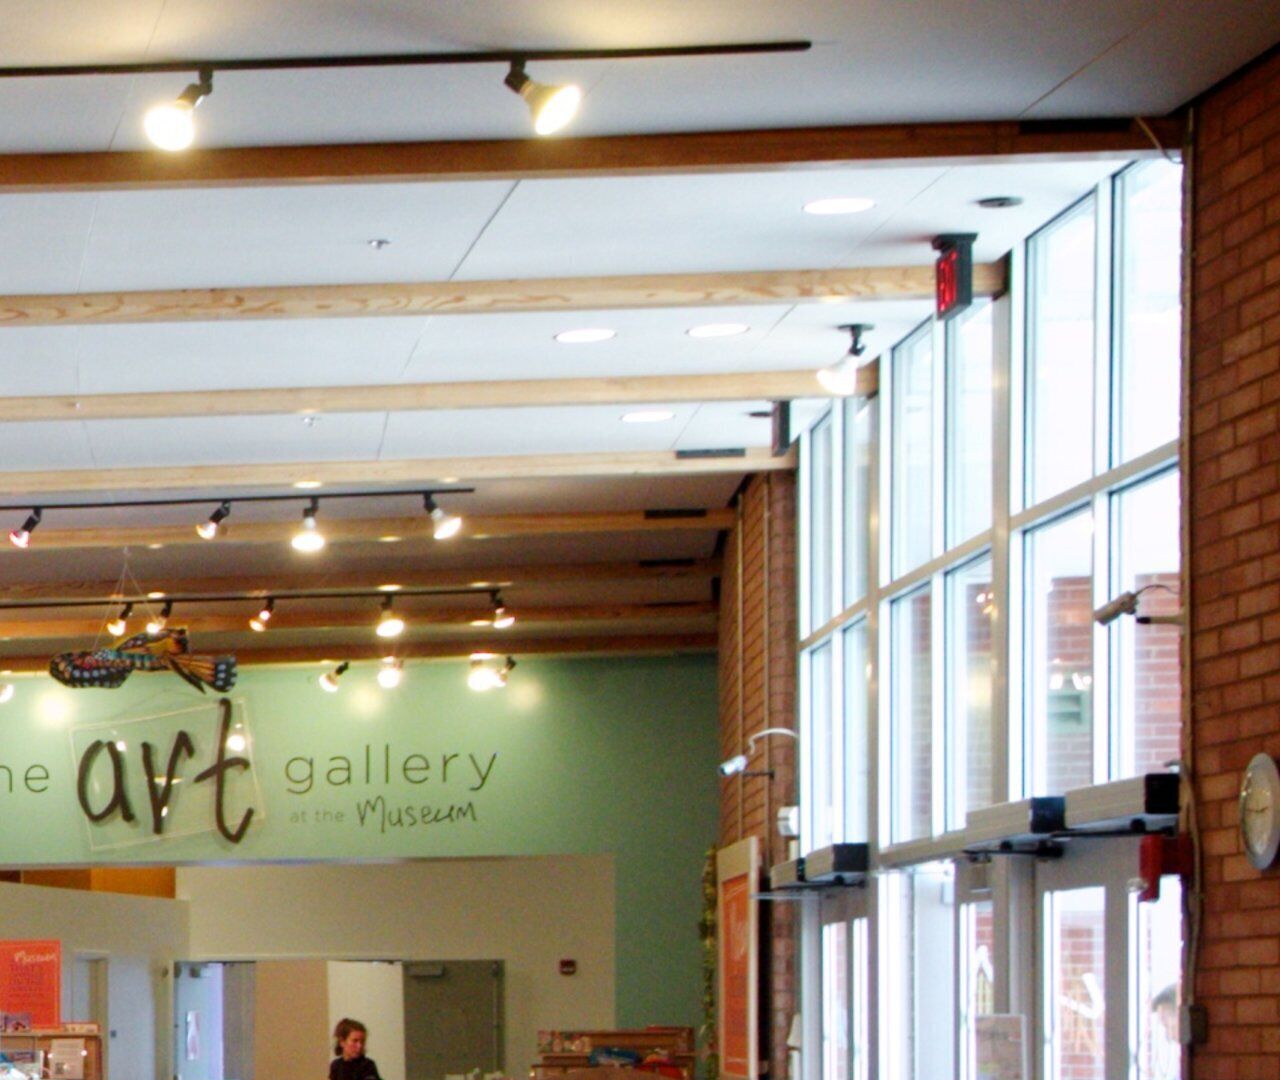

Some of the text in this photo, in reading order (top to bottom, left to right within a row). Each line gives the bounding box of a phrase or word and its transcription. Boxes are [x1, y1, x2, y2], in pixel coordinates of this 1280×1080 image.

[76, 697, 255, 844] art
[284, 743, 498, 795] gallery
[289, 795, 477, 834] at the Museum
